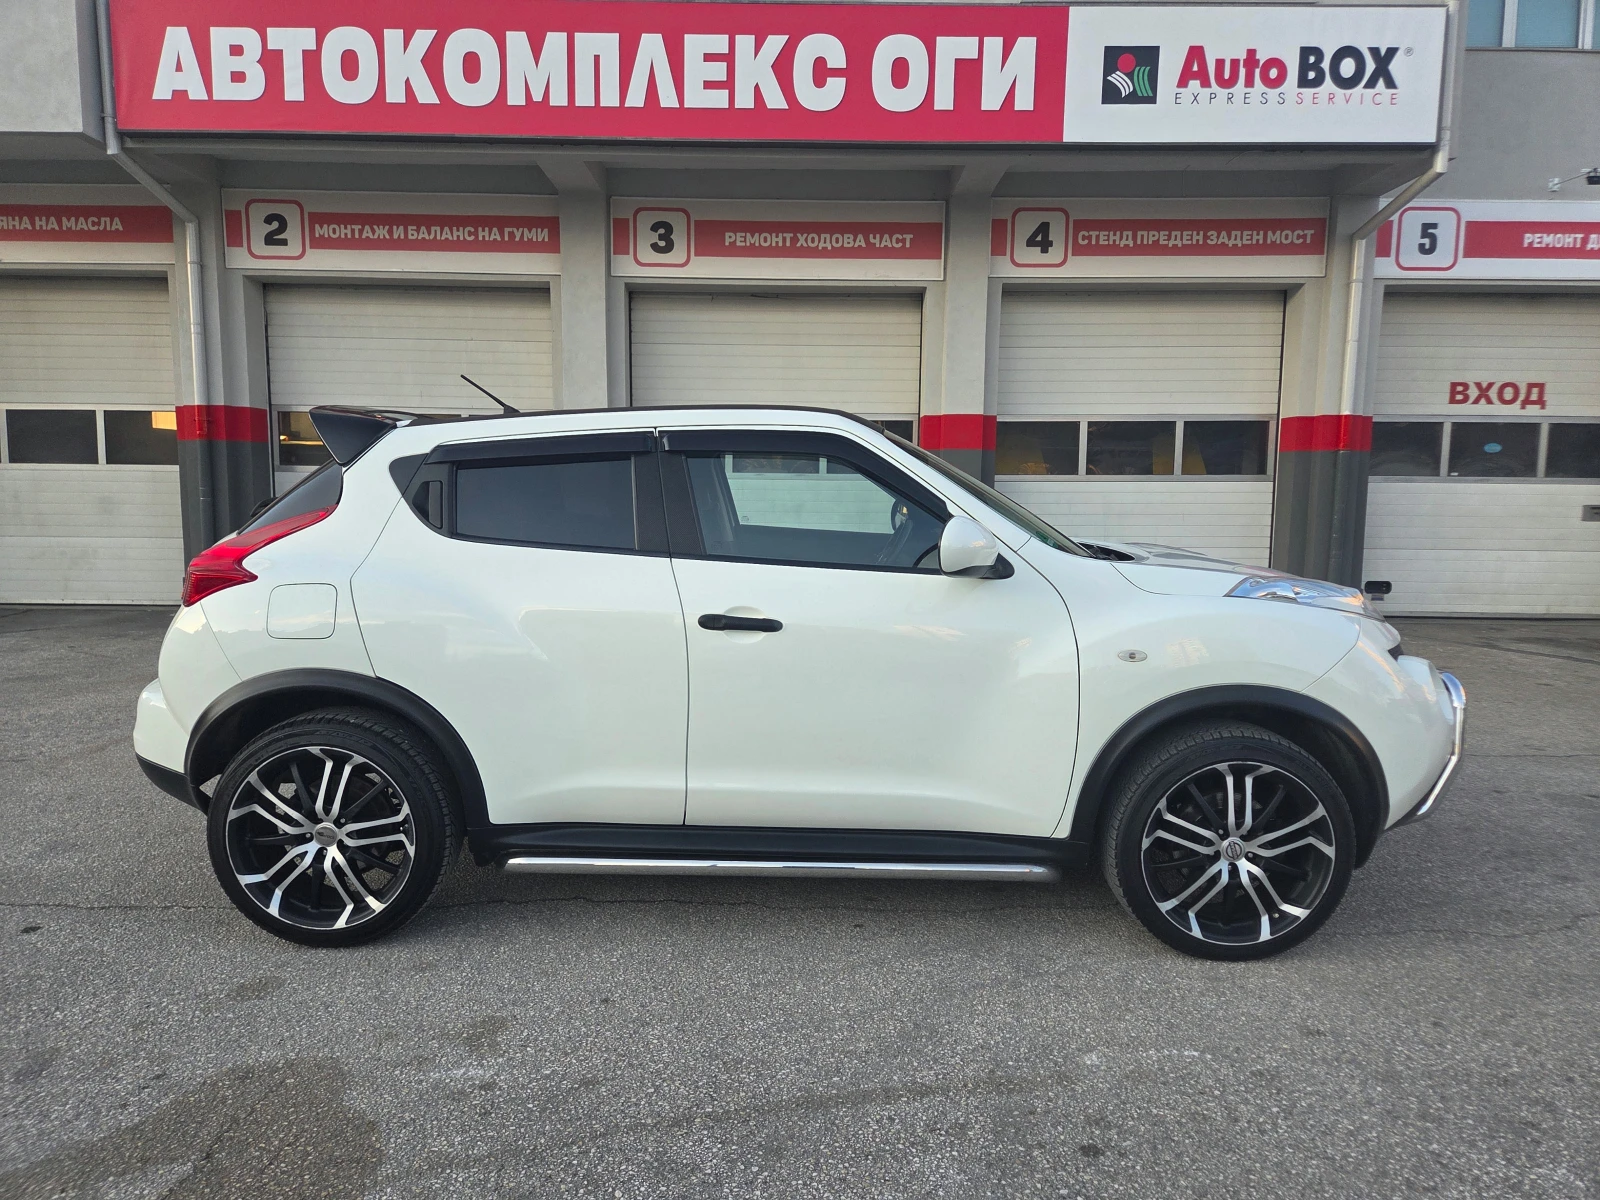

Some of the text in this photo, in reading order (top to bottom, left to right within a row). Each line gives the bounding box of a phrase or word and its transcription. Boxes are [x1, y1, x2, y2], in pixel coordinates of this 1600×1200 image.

[152, 26, 1037, 112] АВТОКОМПЛЕКС ОГИ
[1176, 45, 1400, 90] Auto BOX
[1174, 92, 1398, 106] EXPRESS SERVICE
[35, 216, 59, 231] НА
[61, 216, 123, 231] МАСЛА
[263, 212, 288, 246] 2
[314, 223, 549, 242] МОНТАЖ И БАЛАНС НА ГУМИ
[649, 220, 675, 254] 3
[1025, 221, 1053, 254] 4
[1077, 229, 1315, 247] СТЕНД ПРЕДЕН ЗАДЕН МОСТ
[724, 232, 913, 250] РЕМОНТ ХОДОВА ЧАСТ
[1418, 222, 1439, 255] 5
[1523, 233, 1584, 248] РЕМОНТ
[1447, 381, 1547, 410] ВХОД
